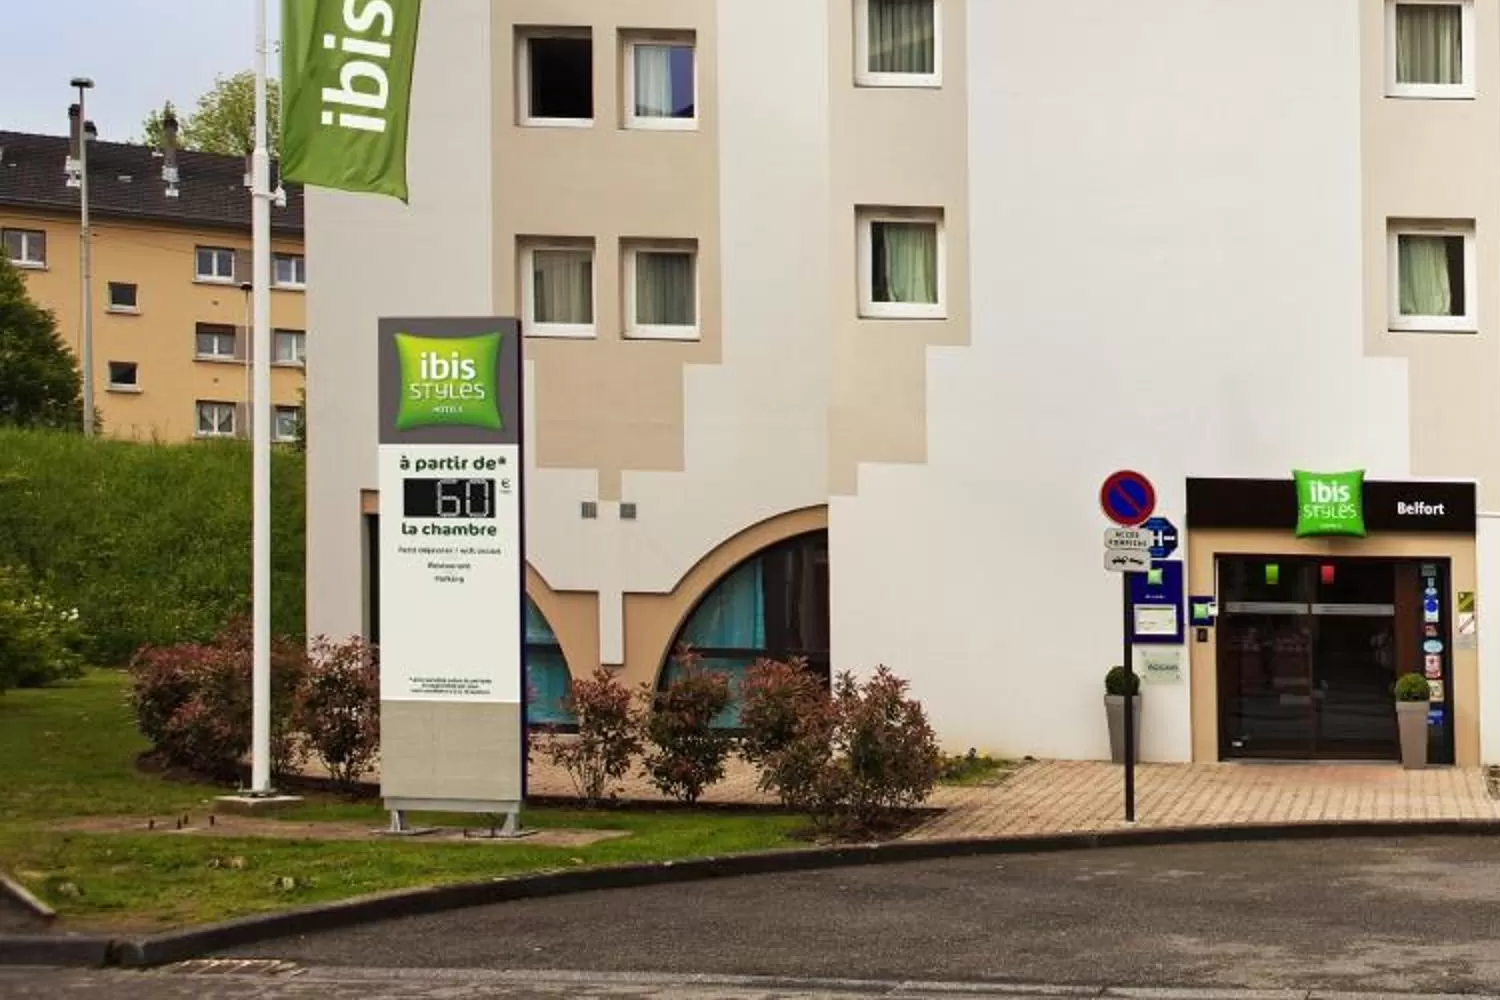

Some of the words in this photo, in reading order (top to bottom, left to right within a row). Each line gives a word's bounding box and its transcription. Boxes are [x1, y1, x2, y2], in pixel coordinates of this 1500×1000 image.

[420, 351, 476, 381] ibis
[415, 456, 468, 473] partir
[437, 478, 489, 518] 60
[1310, 480, 1350, 503] ibis
[1397, 501, 1445, 516] Belfort
[422, 523, 497, 537] chambre
